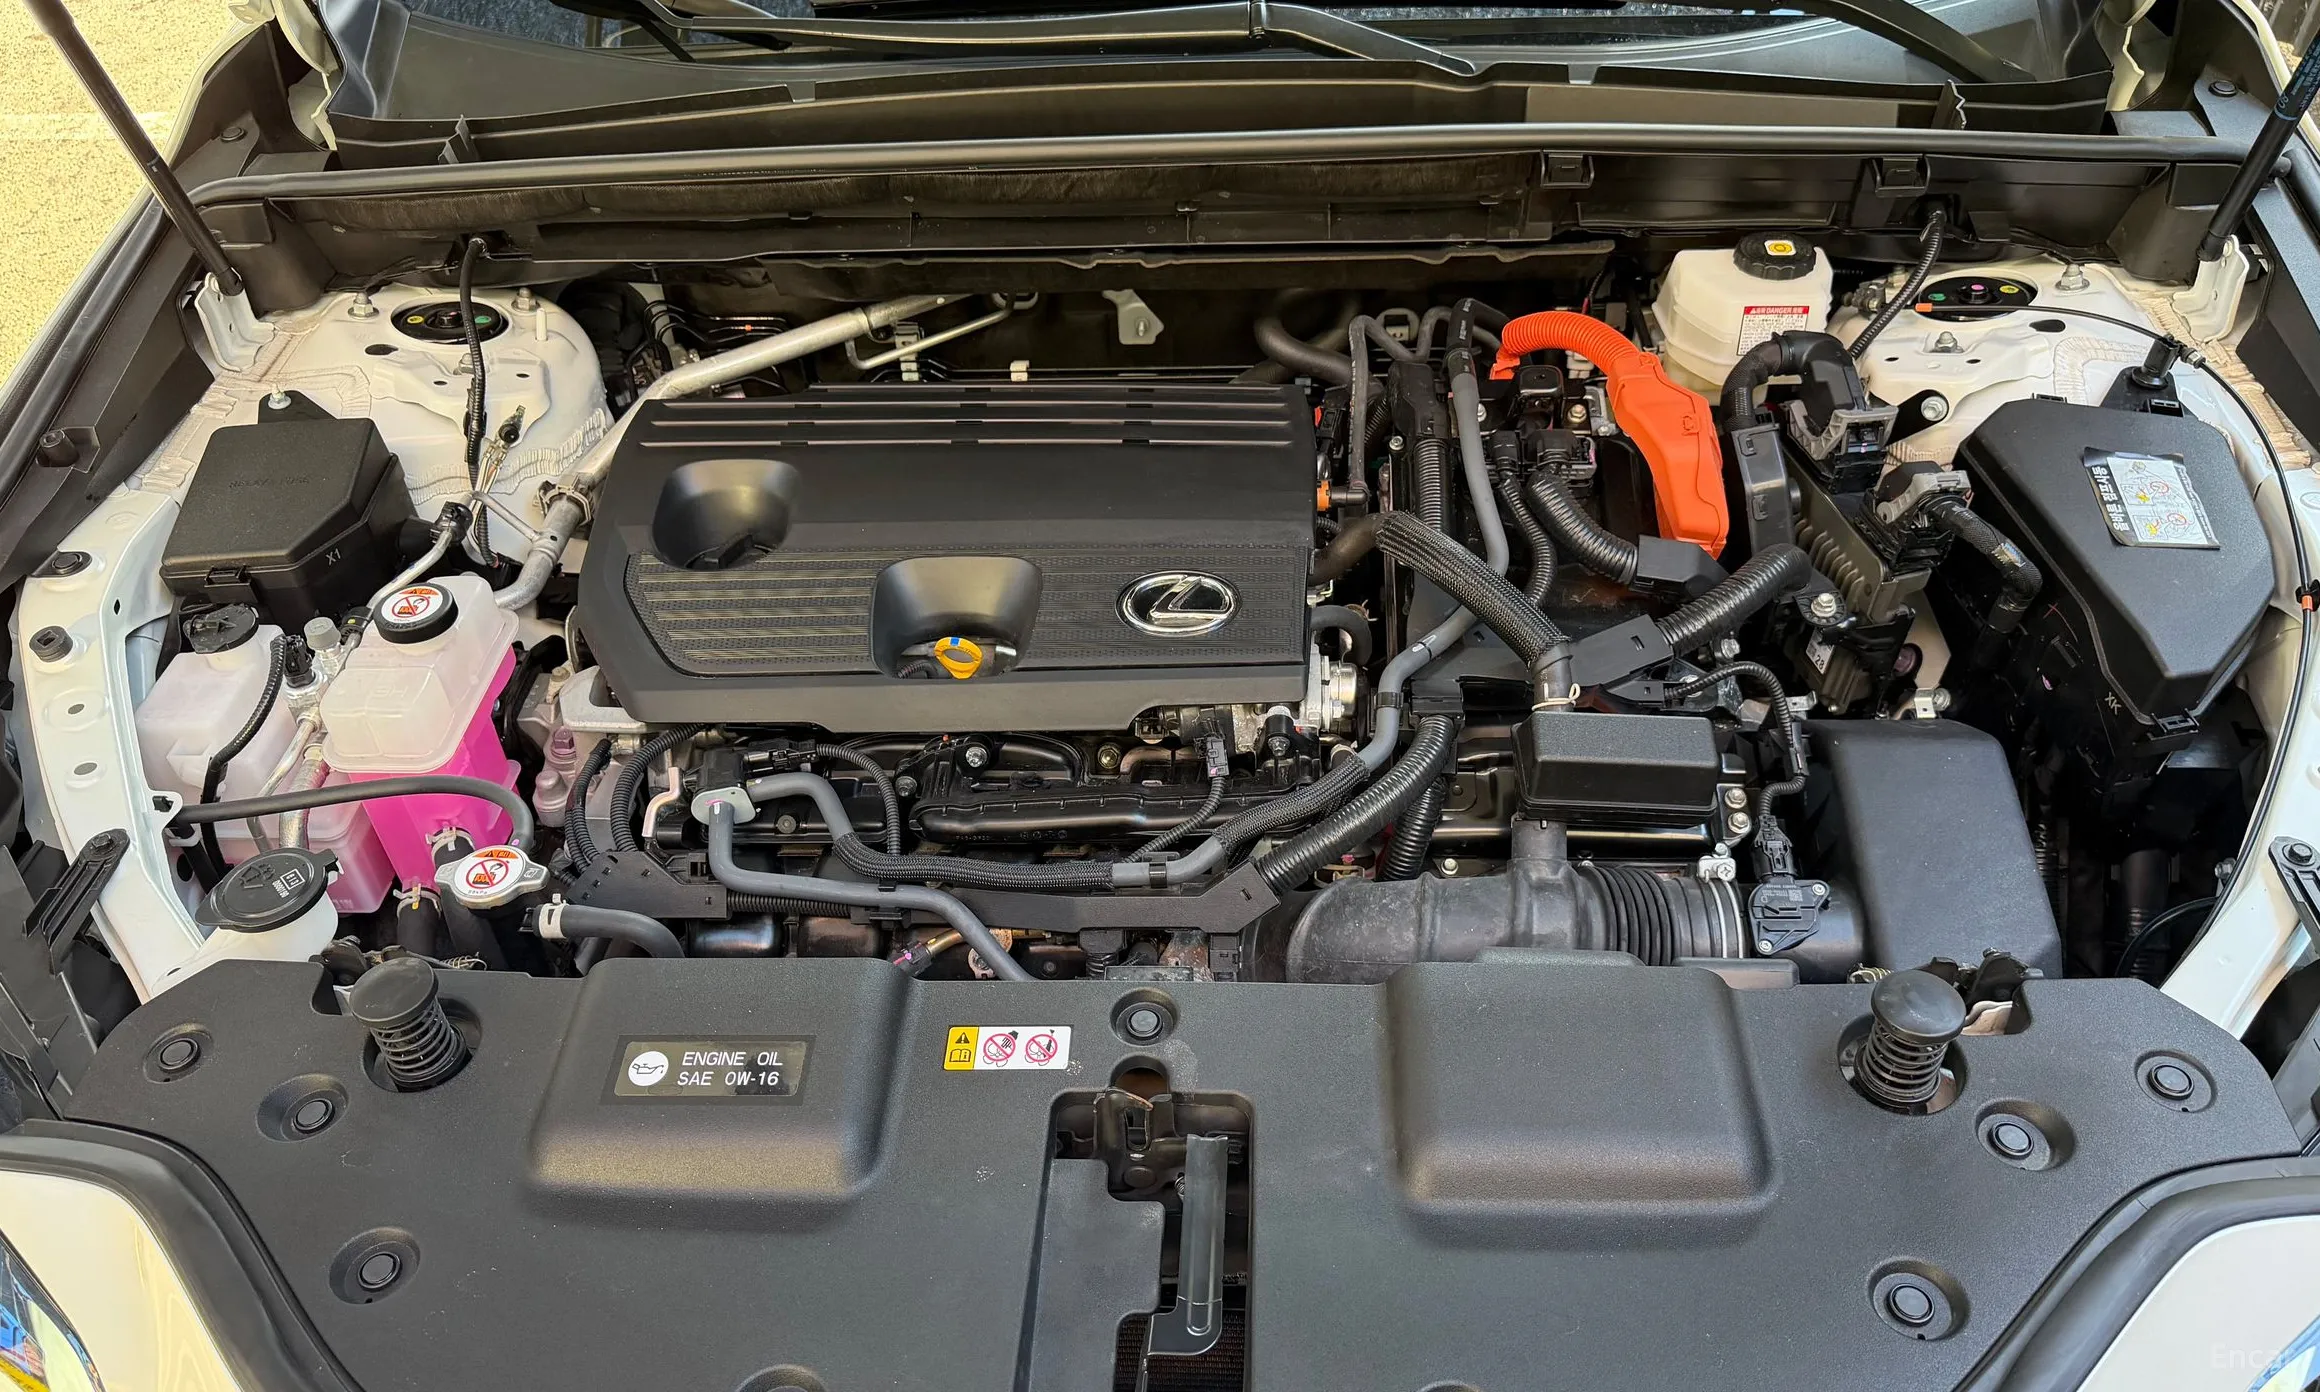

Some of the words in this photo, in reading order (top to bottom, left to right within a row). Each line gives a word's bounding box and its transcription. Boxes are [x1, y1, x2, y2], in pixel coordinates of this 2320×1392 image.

[326, 548, 342, 566] X1
[2104, 691, 2122, 716] XK
[682, 1051, 746, 1066] ENGINE
[757, 1051, 783, 1066] OIL
[677, 1071, 714, 1086] SAE
[725, 1071, 779, 1086] 0W-16
